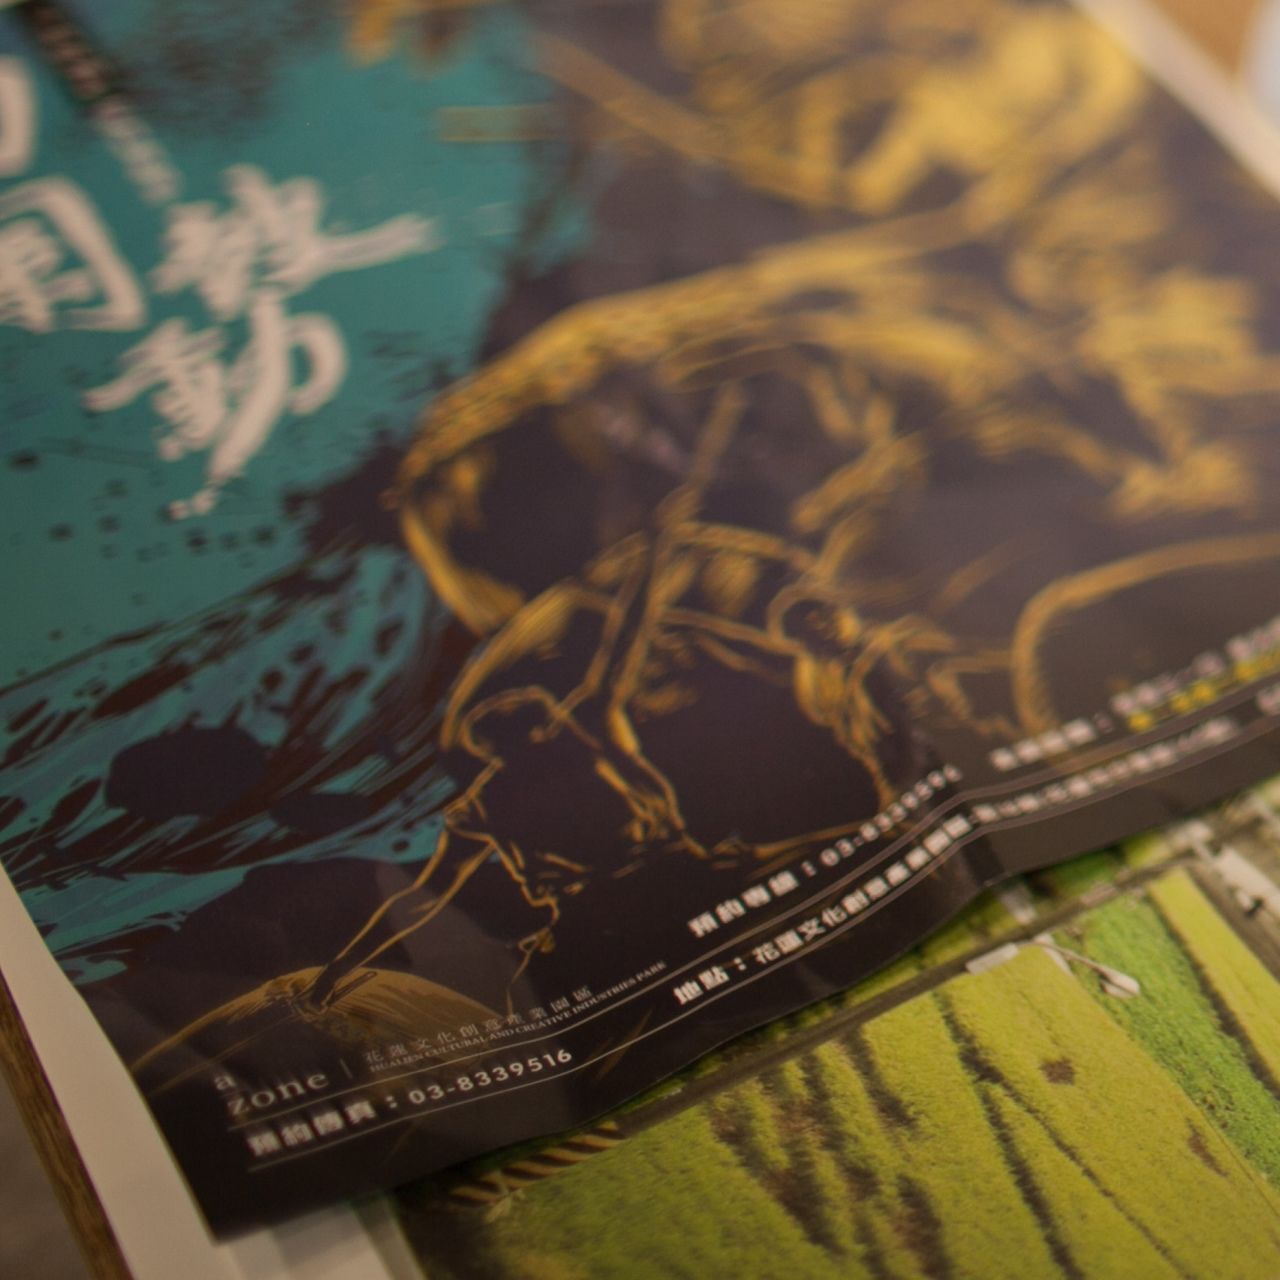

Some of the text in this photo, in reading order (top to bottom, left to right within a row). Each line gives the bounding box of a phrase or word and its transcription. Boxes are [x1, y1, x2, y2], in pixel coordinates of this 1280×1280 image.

[370, 960, 668, 1073] HUALIEN CULTURAL AND CREATIVE INDUSTRIES PARK
[227, 1070, 330, 1116] zone
